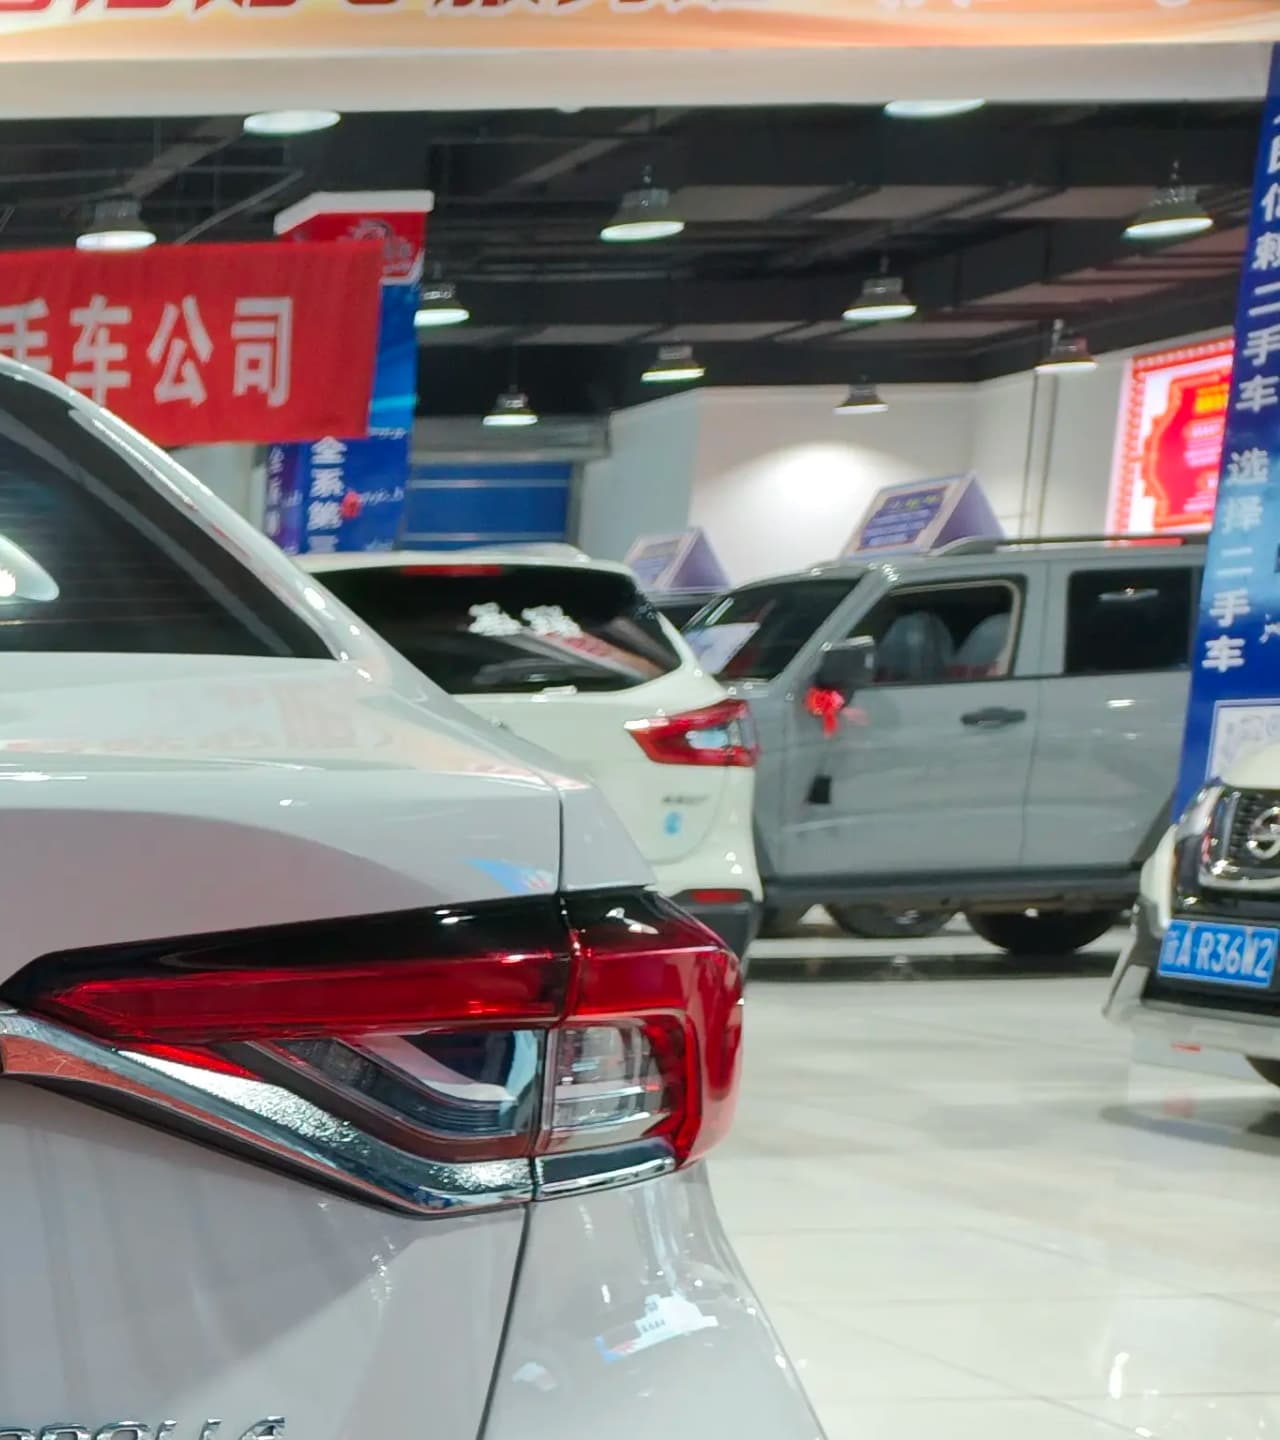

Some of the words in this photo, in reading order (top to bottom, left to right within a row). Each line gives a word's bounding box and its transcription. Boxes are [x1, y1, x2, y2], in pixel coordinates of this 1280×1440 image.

[1202, 447, 1269, 673] 选择二手车
